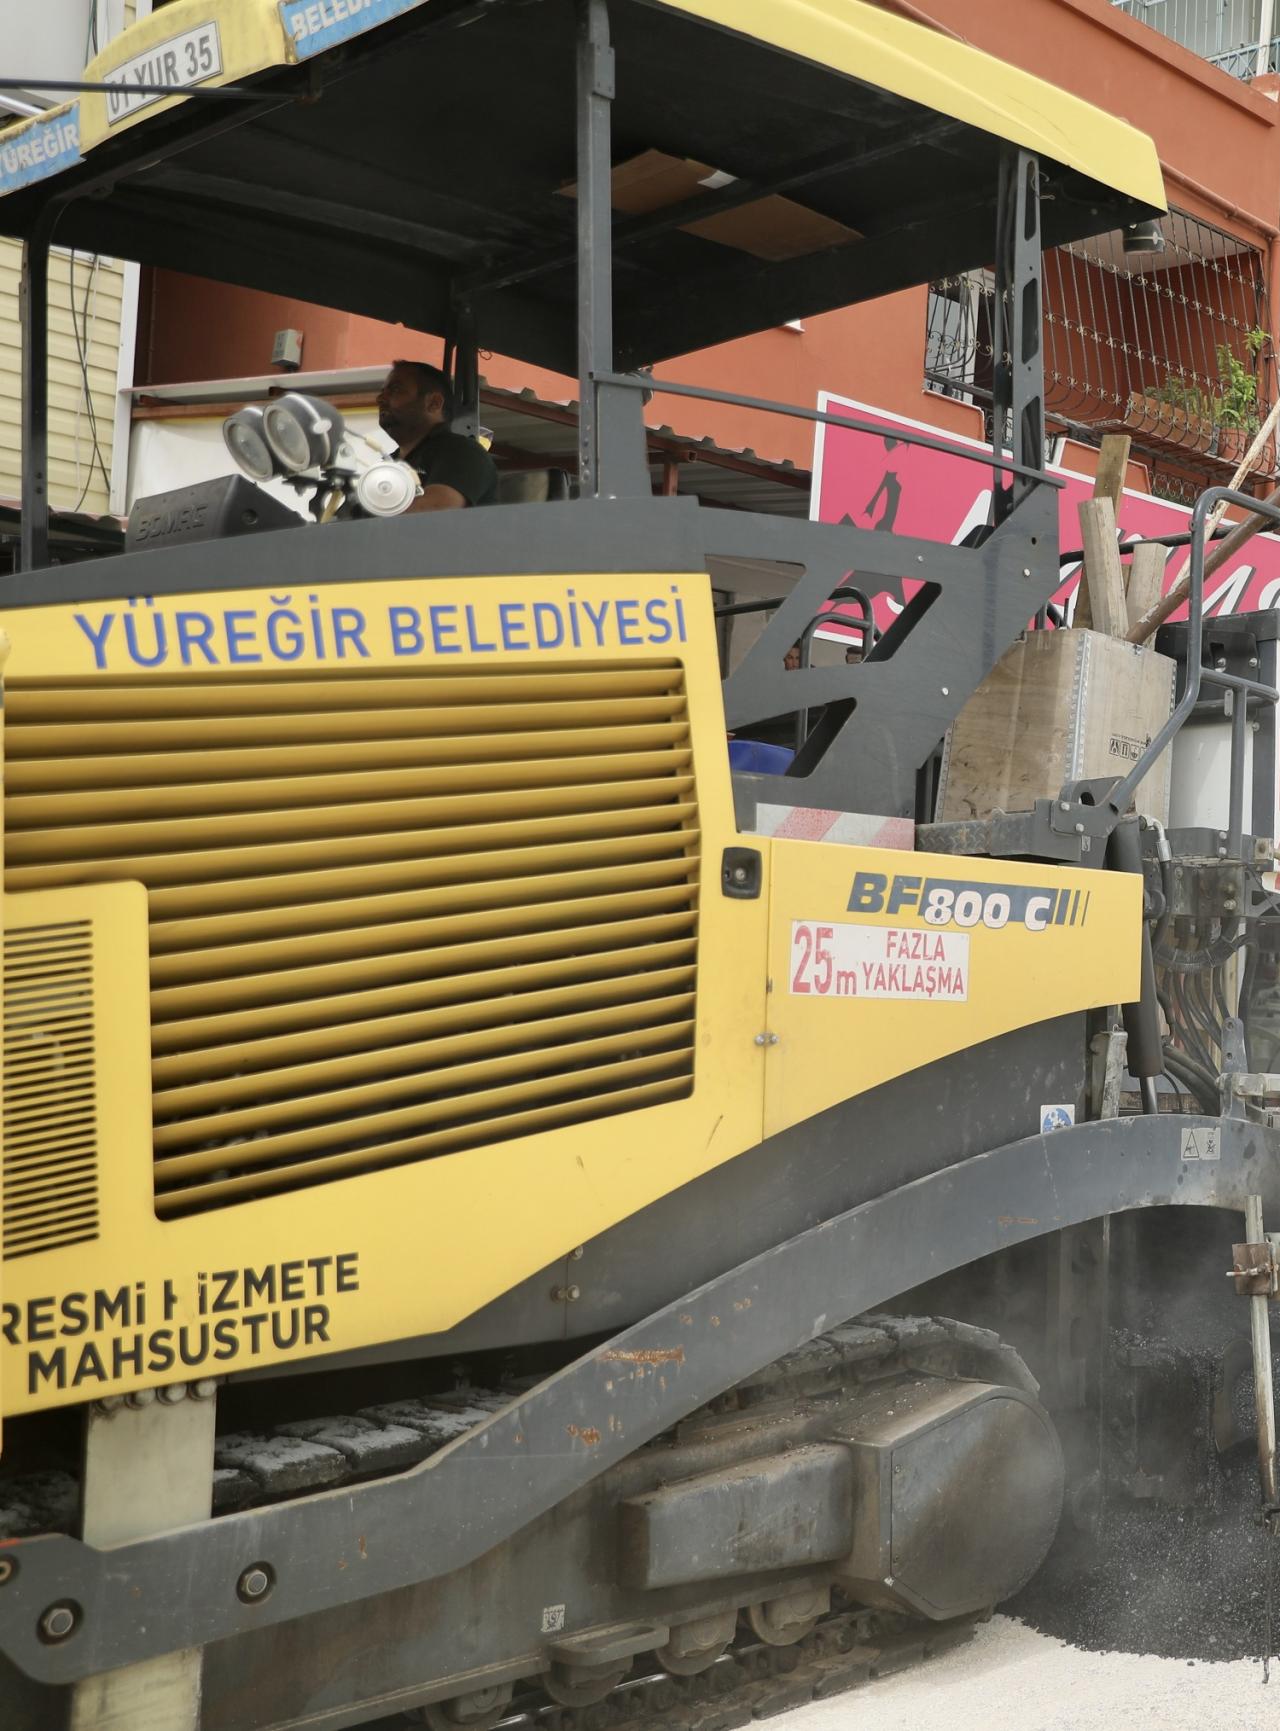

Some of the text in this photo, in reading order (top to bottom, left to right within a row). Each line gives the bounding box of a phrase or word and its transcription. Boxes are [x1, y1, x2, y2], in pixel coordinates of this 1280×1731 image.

[291, 0, 383, 40] BELED
[184, 35, 214, 78] 35
[73, 585, 688, 670] YÜREĞİR BELEDİYESİ
[1024, 896, 1051, 932] C
[886, 930, 945, 962] FAZLA
[863, 962, 964, 997] YAKLAŞMA
[28, 1304, 331, 1395] MAHSUSTUR
